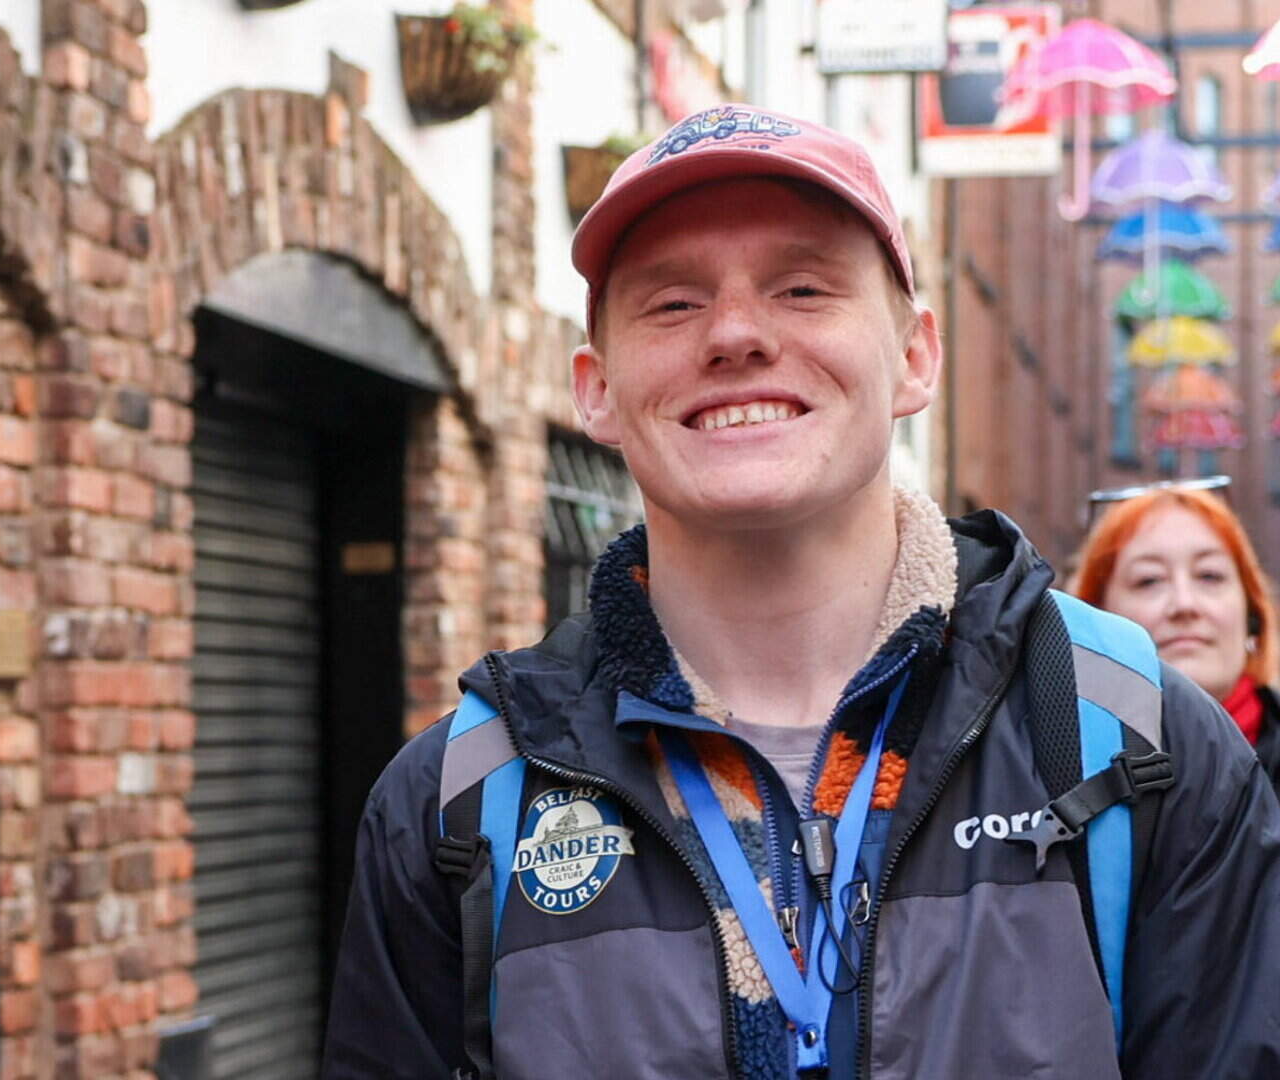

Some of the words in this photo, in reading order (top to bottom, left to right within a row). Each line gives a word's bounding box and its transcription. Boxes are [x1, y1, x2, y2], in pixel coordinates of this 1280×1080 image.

[535, 787, 603, 813] BELFAST
[518, 835, 620, 869] DANDER
[546, 870, 584, 883] CULTURE
[548, 864, 575, 875] CRAIC
[575, 863, 582, 871] &
[532, 875, 602, 908] TOURS
